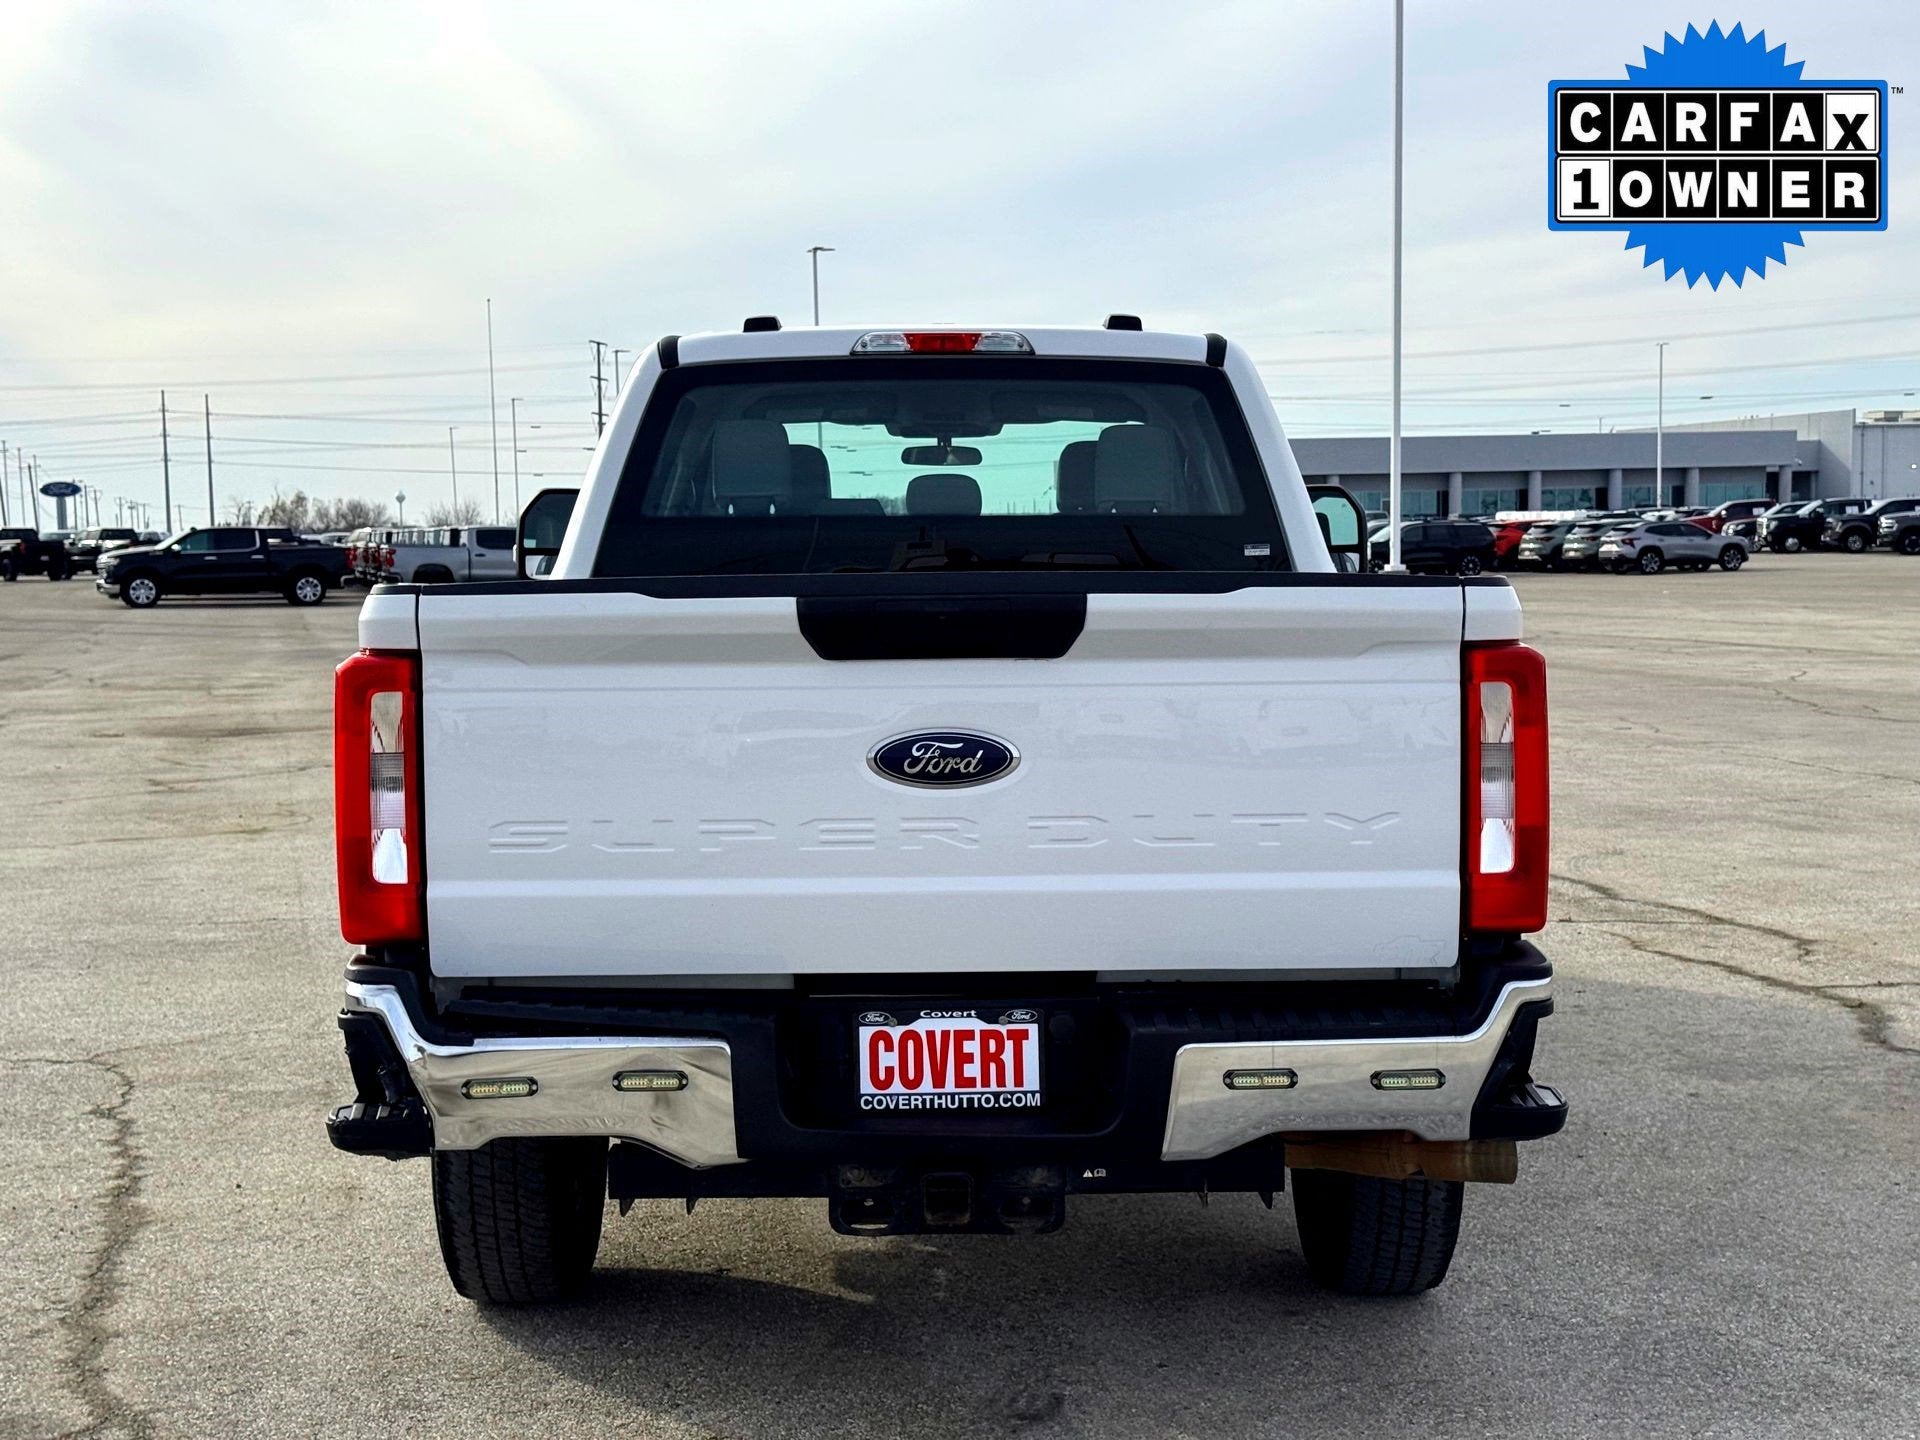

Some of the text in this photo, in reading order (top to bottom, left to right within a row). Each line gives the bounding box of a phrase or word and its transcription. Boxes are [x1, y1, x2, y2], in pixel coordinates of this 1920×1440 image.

[903, 741, 984, 774] Ford
[488, 811, 1401, 854] SUPER DUTY
[864, 1012, 886, 1023] Ford
[919, 1009, 978, 1018] Covert
[1010, 1010, 1032, 1021] Ford
[868, 1028, 1030, 1091] COVERT
[860, 1093, 1041, 1110] COVERTHUTTO.COM
